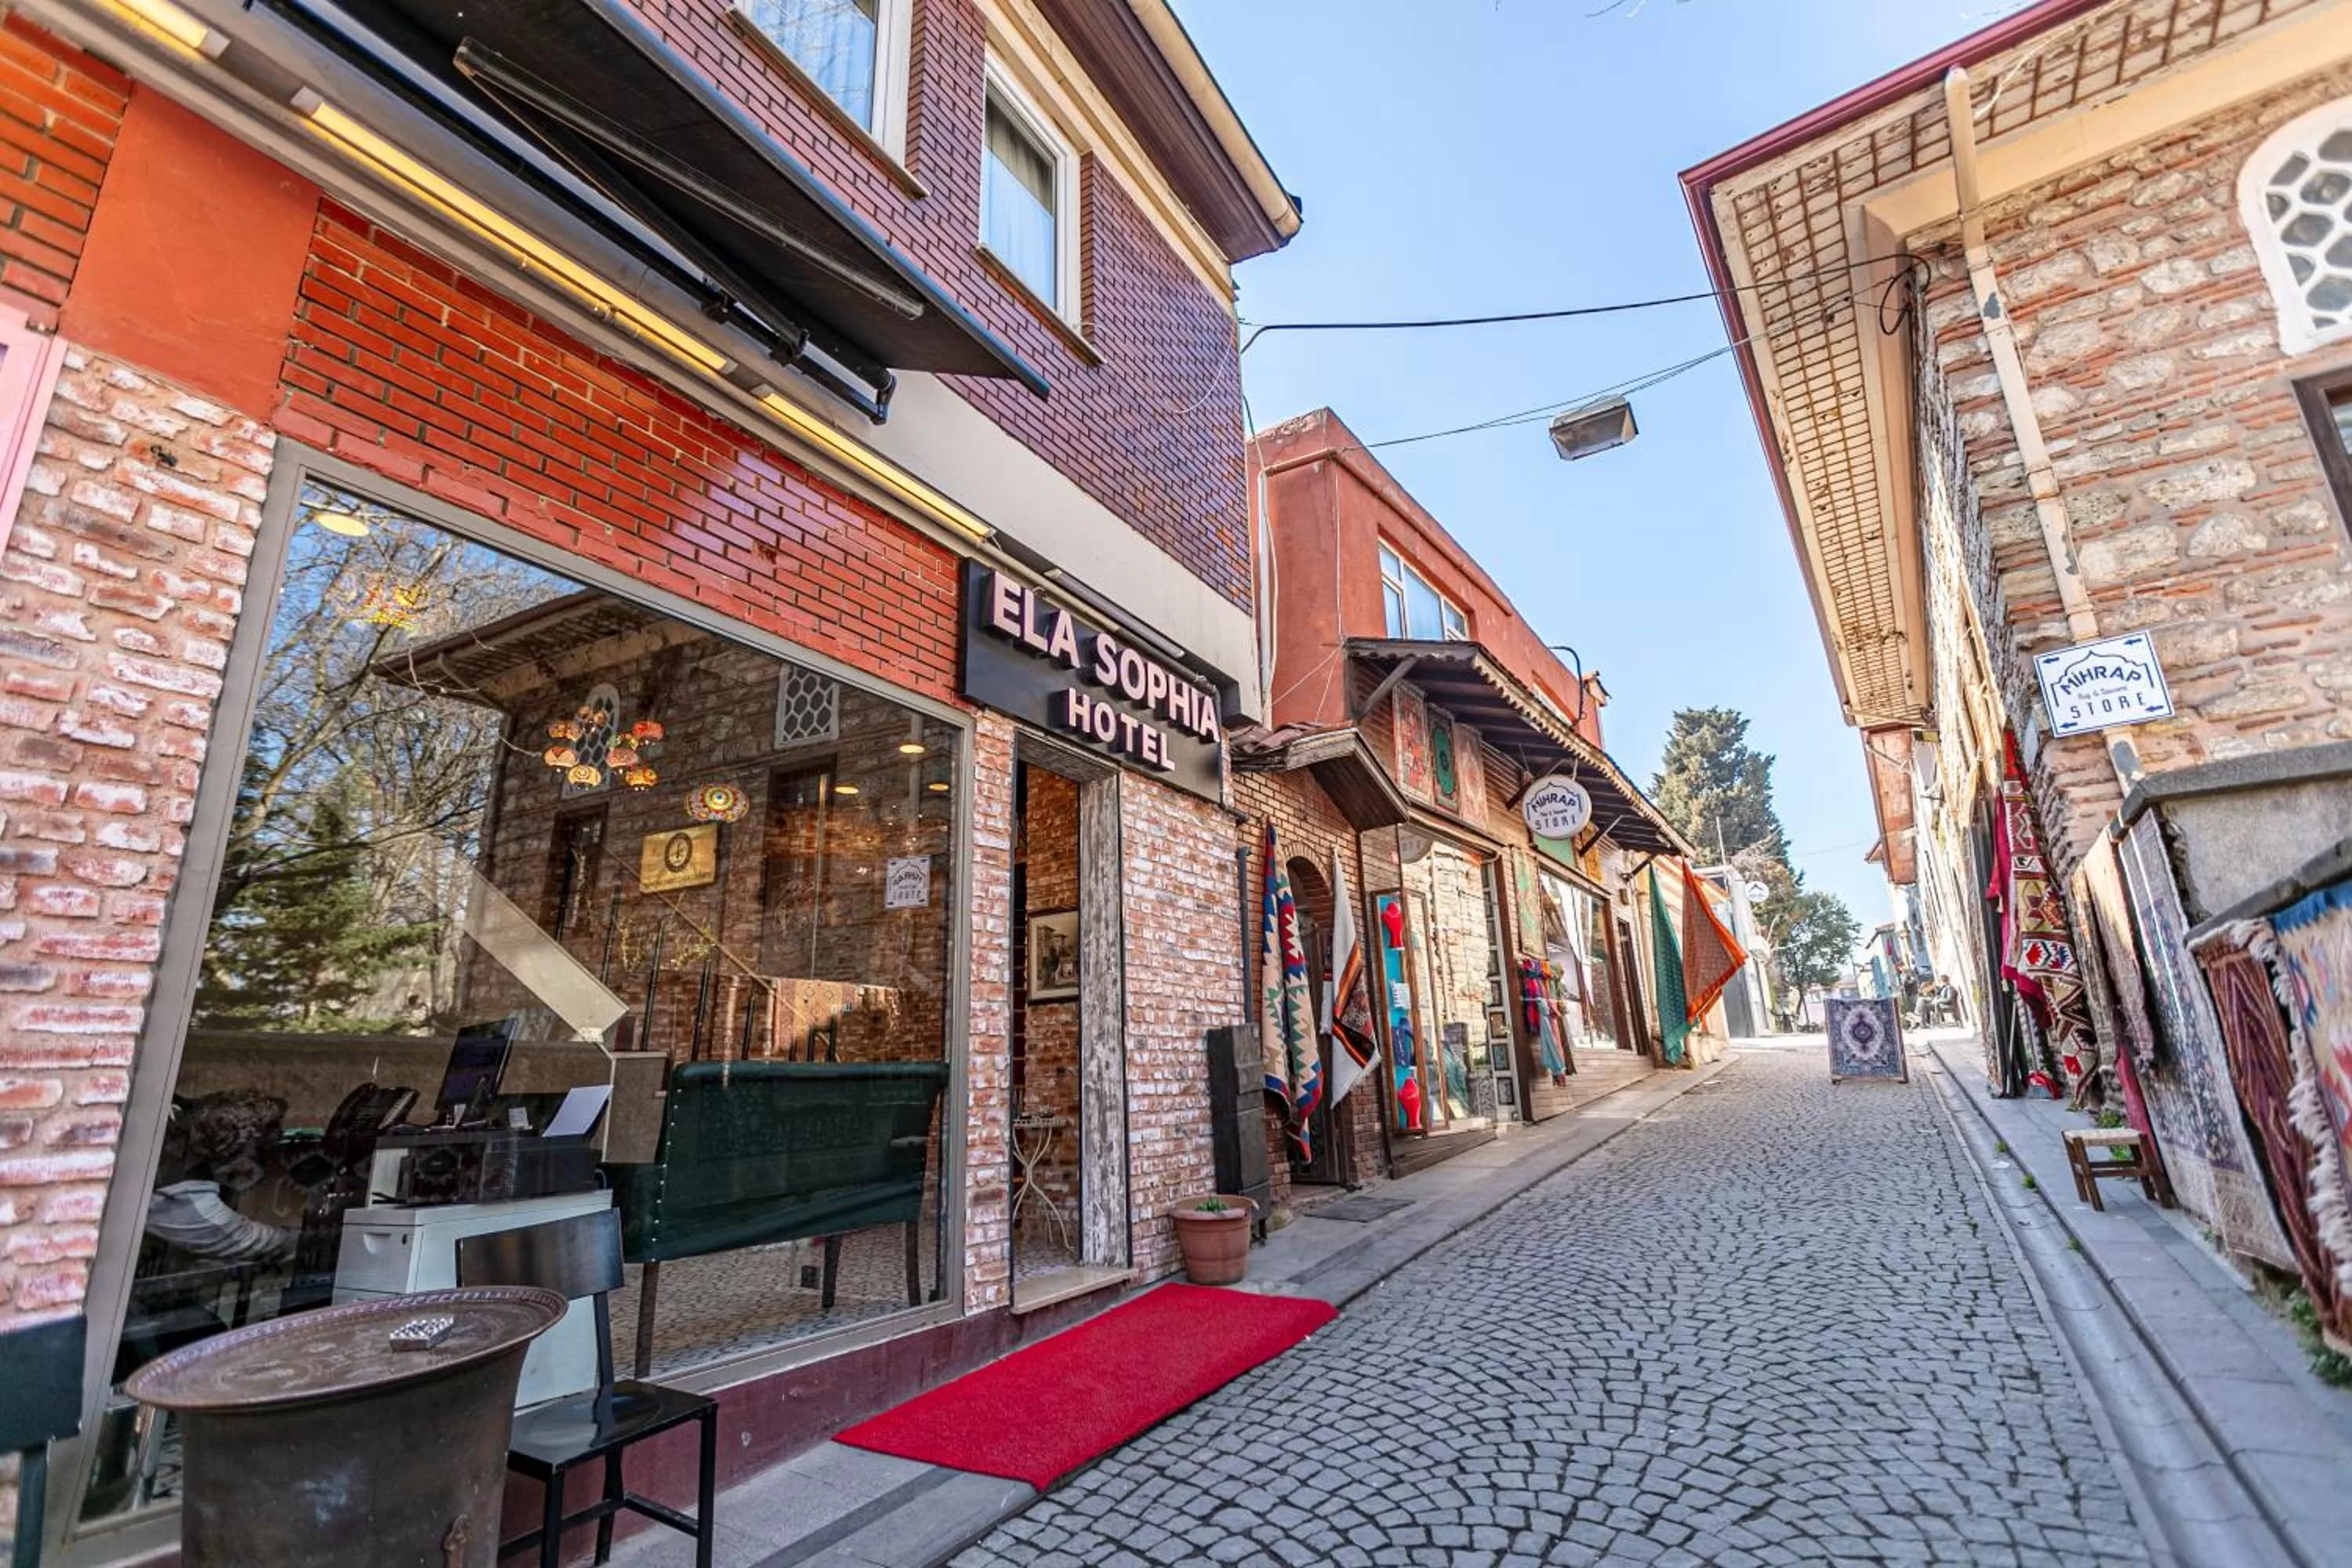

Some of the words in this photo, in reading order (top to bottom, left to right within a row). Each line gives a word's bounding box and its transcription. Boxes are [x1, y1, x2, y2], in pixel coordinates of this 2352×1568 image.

[990, 571, 1080, 669] ELA
[1095, 632, 1220, 742] SOPHIA
[1066, 687, 1175, 771] HOTEL
[2070, 692, 2145, 719] STORE
